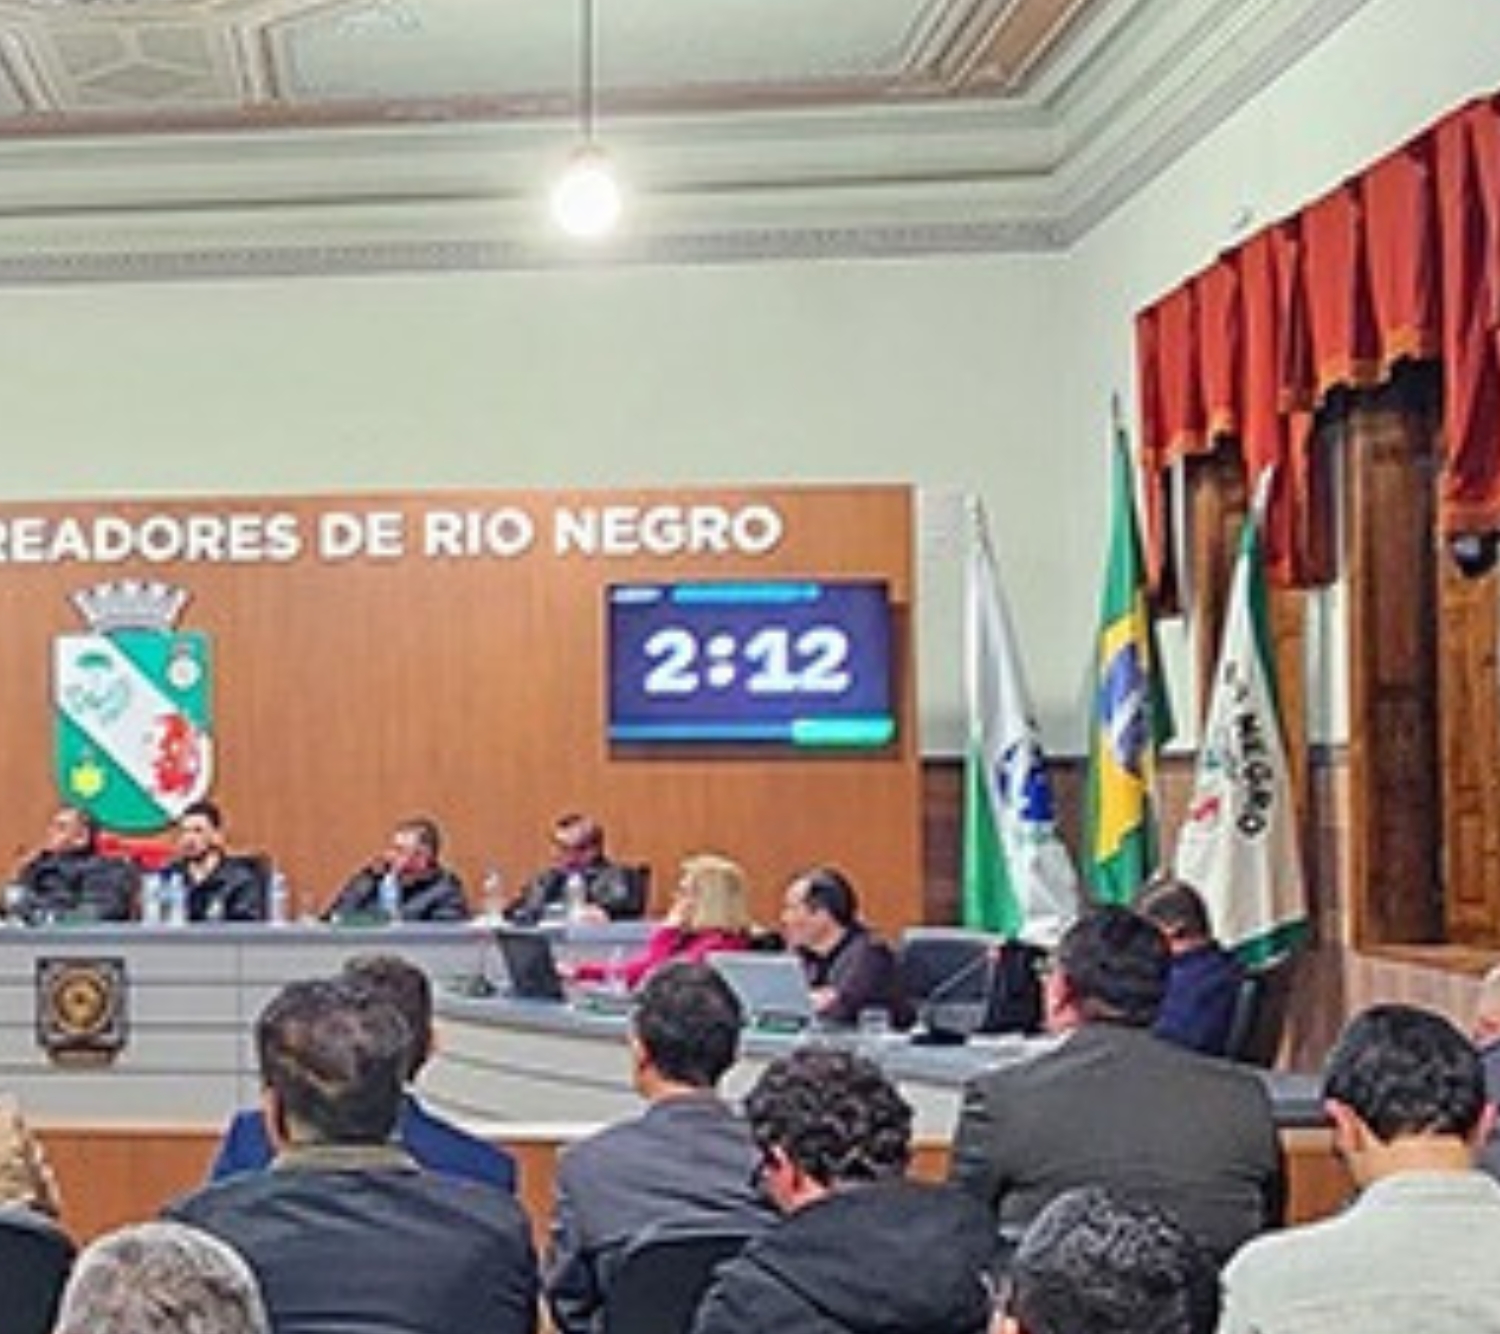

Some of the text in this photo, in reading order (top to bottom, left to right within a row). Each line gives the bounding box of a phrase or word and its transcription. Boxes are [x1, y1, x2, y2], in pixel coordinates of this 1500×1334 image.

[320, 510, 402, 558] DE
[424, 508, 535, 557] RIO
[553, 504, 783, 555] NEGRO
[643, 626, 850, 693] 2:12
